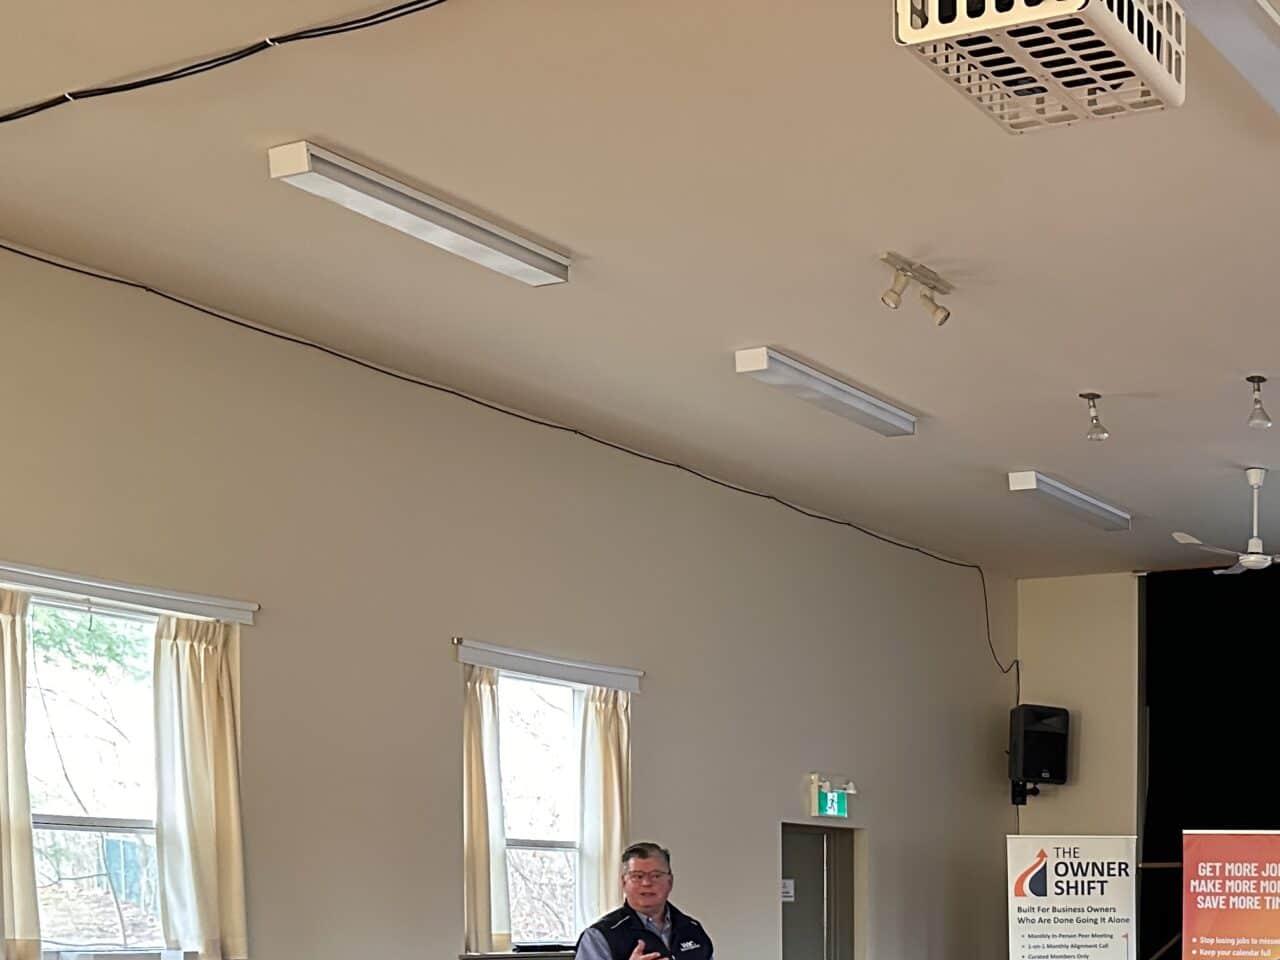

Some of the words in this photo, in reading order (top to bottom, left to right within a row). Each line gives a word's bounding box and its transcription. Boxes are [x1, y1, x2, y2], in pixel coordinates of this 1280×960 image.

[1053, 847, 1080, 858] THE
[1054, 862, 1129, 877] OWNER
[1198, 863, 1222, 876] GET
[1225, 863, 1259, 877] MORE
[1054, 880, 1108, 896] SHIFT
[1190, 880, 1223, 893] MAKE
[1225, 880, 1257, 893] MORE
[1197, 896, 1226, 909] SAVE
[1229, 896, 1261, 909] MORE
[1076, 917, 1098, 925] Going
[1108, 916, 1130, 924] Alone
[1200, 937, 1215, 945] Stop
[1236, 937, 1250, 945] jobs
[1200, 949, 1216, 957] Keep
